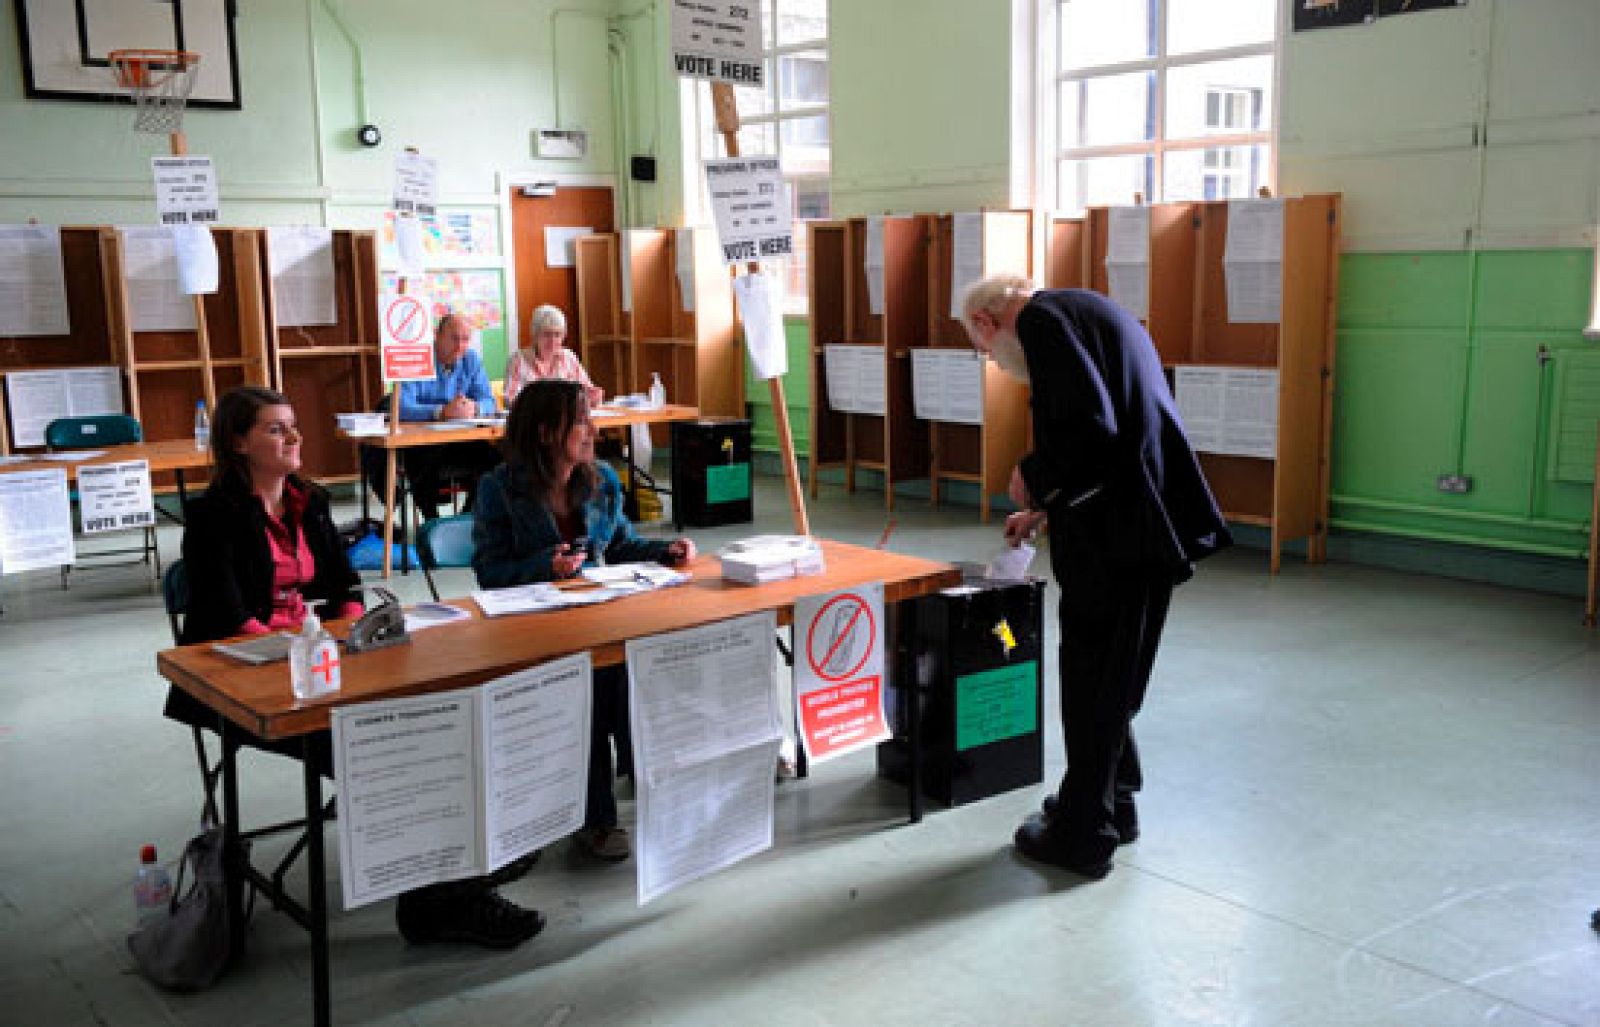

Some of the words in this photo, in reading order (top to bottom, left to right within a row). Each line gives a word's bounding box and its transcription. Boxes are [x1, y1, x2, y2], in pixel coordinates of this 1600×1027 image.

[675, 53, 715, 77] VOTE
[721, 61, 764, 83] HERE
[163, 211, 188, 224] VOTE
[191, 209, 217, 222] HERE
[724, 241, 756, 261] VOTE
[759, 236, 791, 256] HERE
[86, 516, 116, 531] VOTE
[122, 512, 150, 525] HERE
